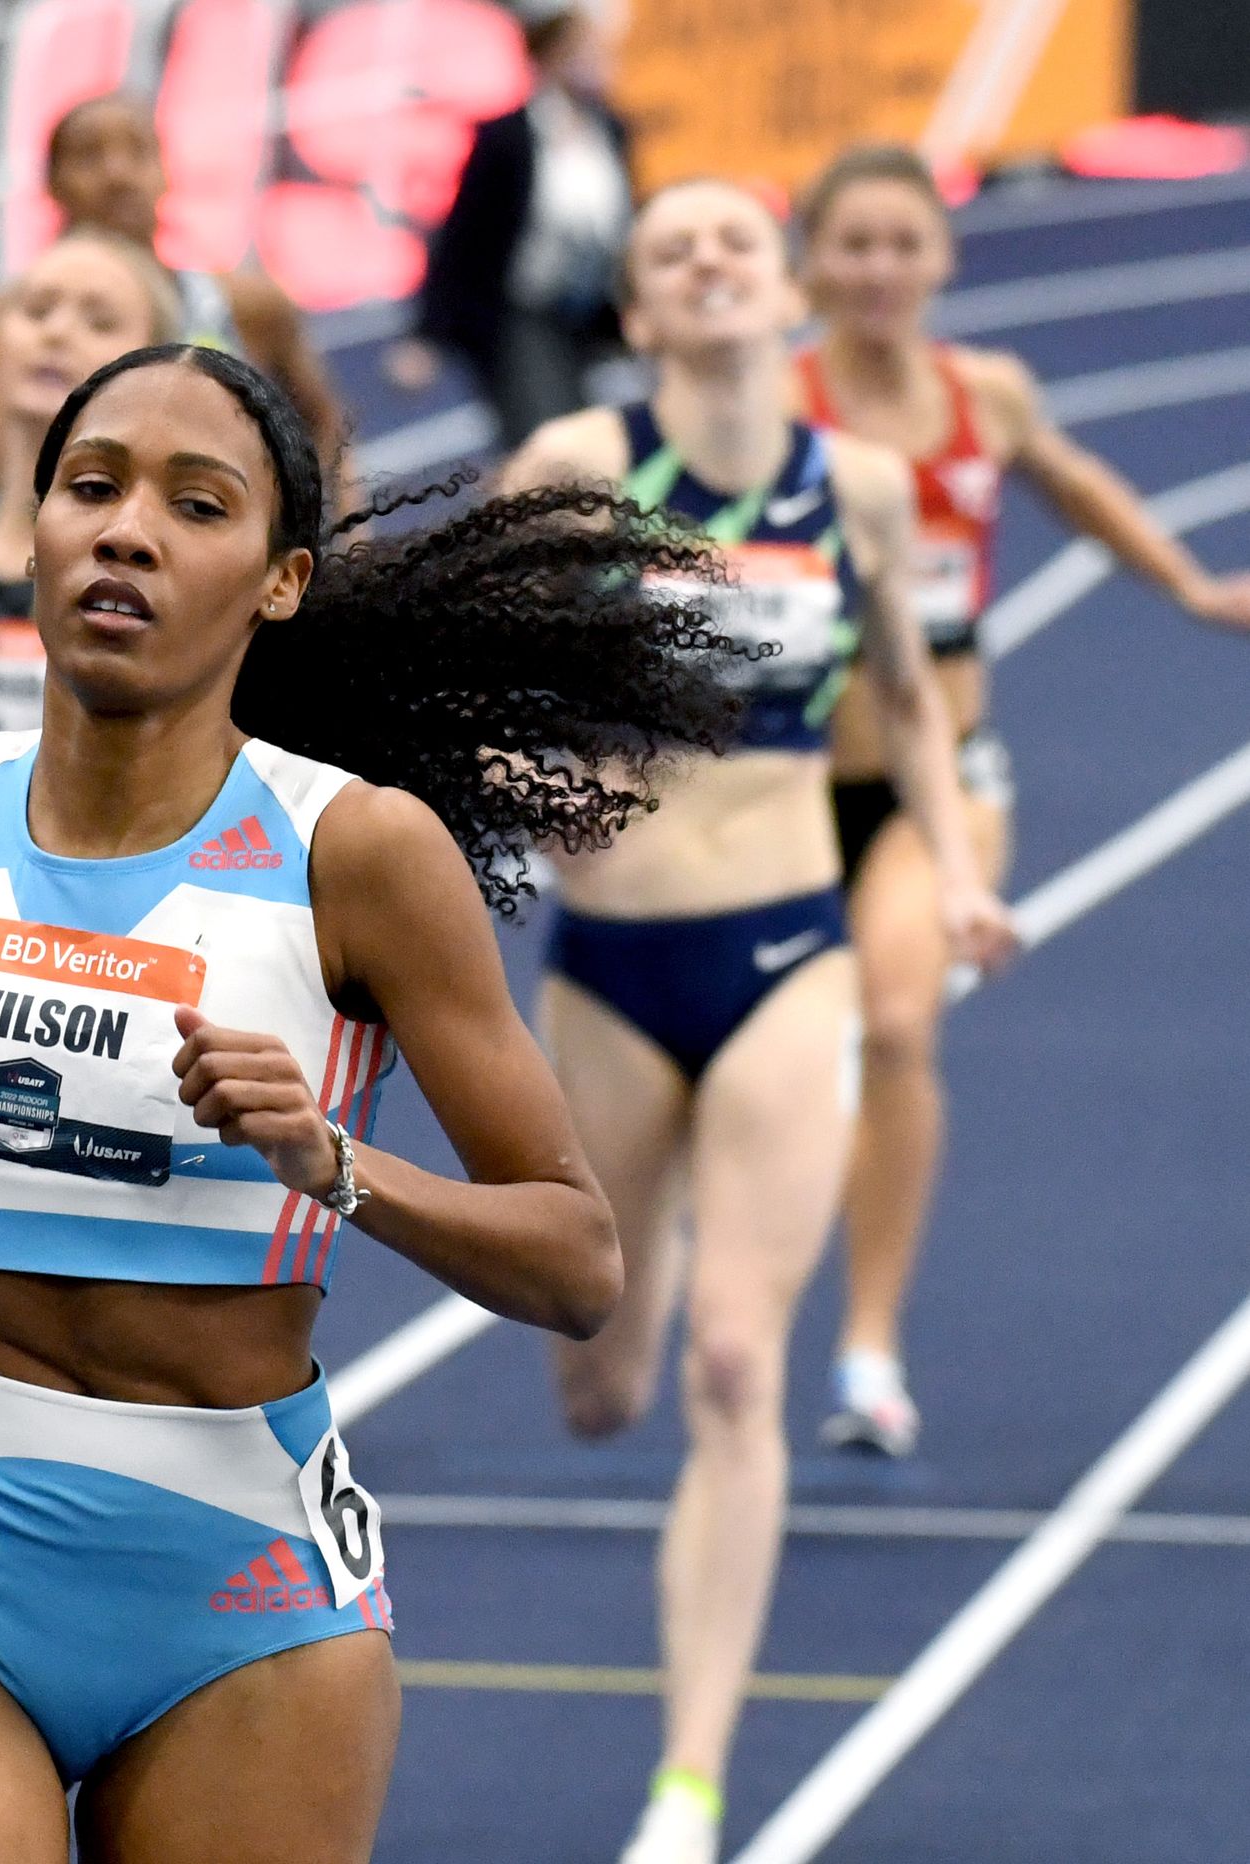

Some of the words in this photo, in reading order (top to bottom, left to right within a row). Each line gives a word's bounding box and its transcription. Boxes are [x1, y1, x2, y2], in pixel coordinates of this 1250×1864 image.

[188, 849, 284, 871] adidas
[0, 933, 47, 965] BD
[17, 1075, 46, 1088] USATF
[92, 1146, 142, 1163] USATF
[320, 1436, 372, 1580] 6
[208, 1584, 331, 1615] adidas
